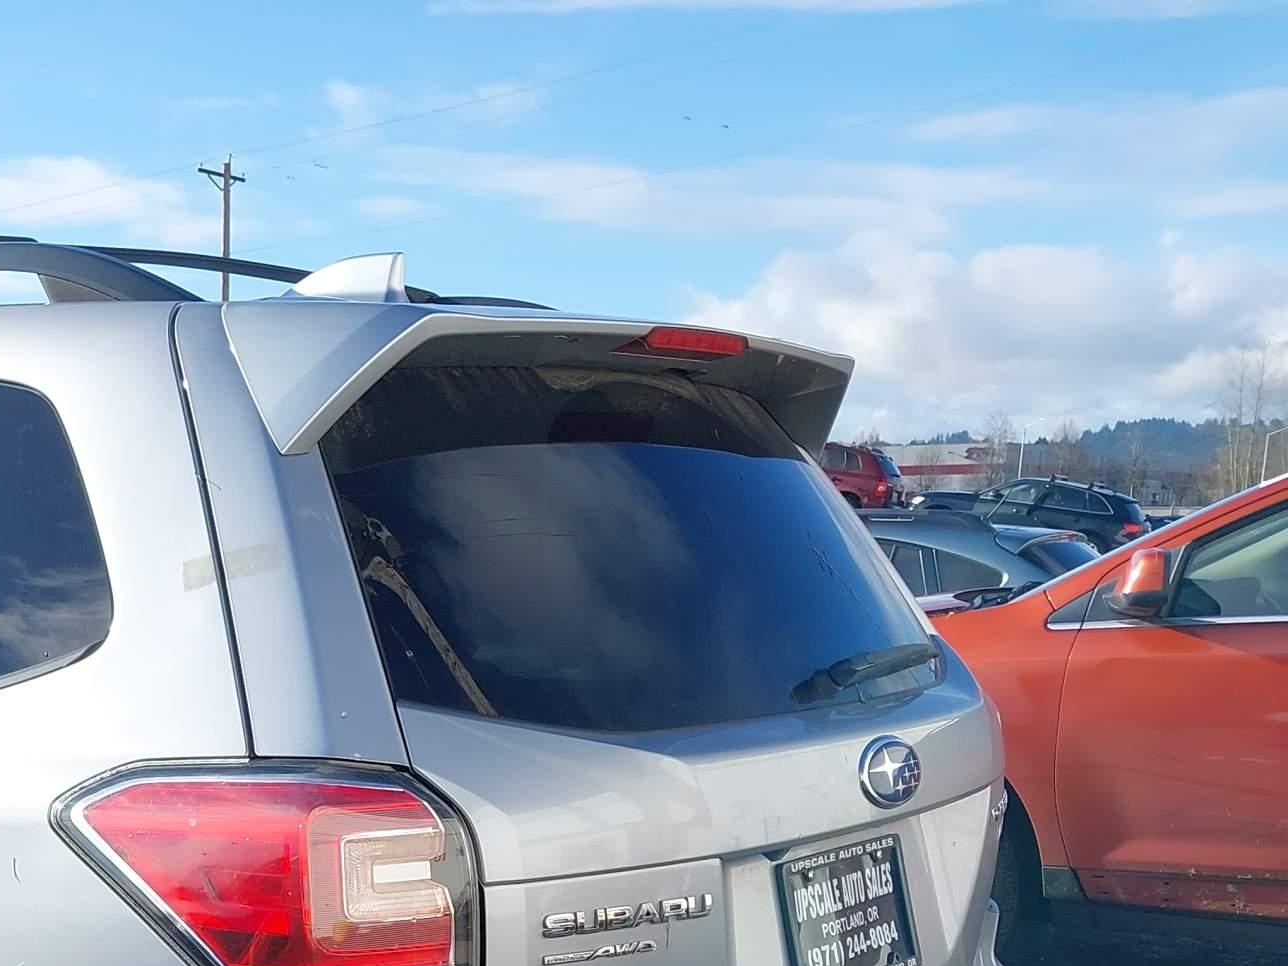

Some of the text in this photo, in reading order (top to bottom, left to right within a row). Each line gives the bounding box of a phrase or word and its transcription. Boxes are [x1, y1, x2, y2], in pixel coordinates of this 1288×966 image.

[791, 837, 894, 872] UPSCALE AUTO SALES
[793, 861, 894, 923] UPSCALE AUTO SALES
[542, 893, 713, 938] SUBARU
[822, 906, 880, 938] PORTLAND, OR
[846, 920, 899, 959] 244-8084
